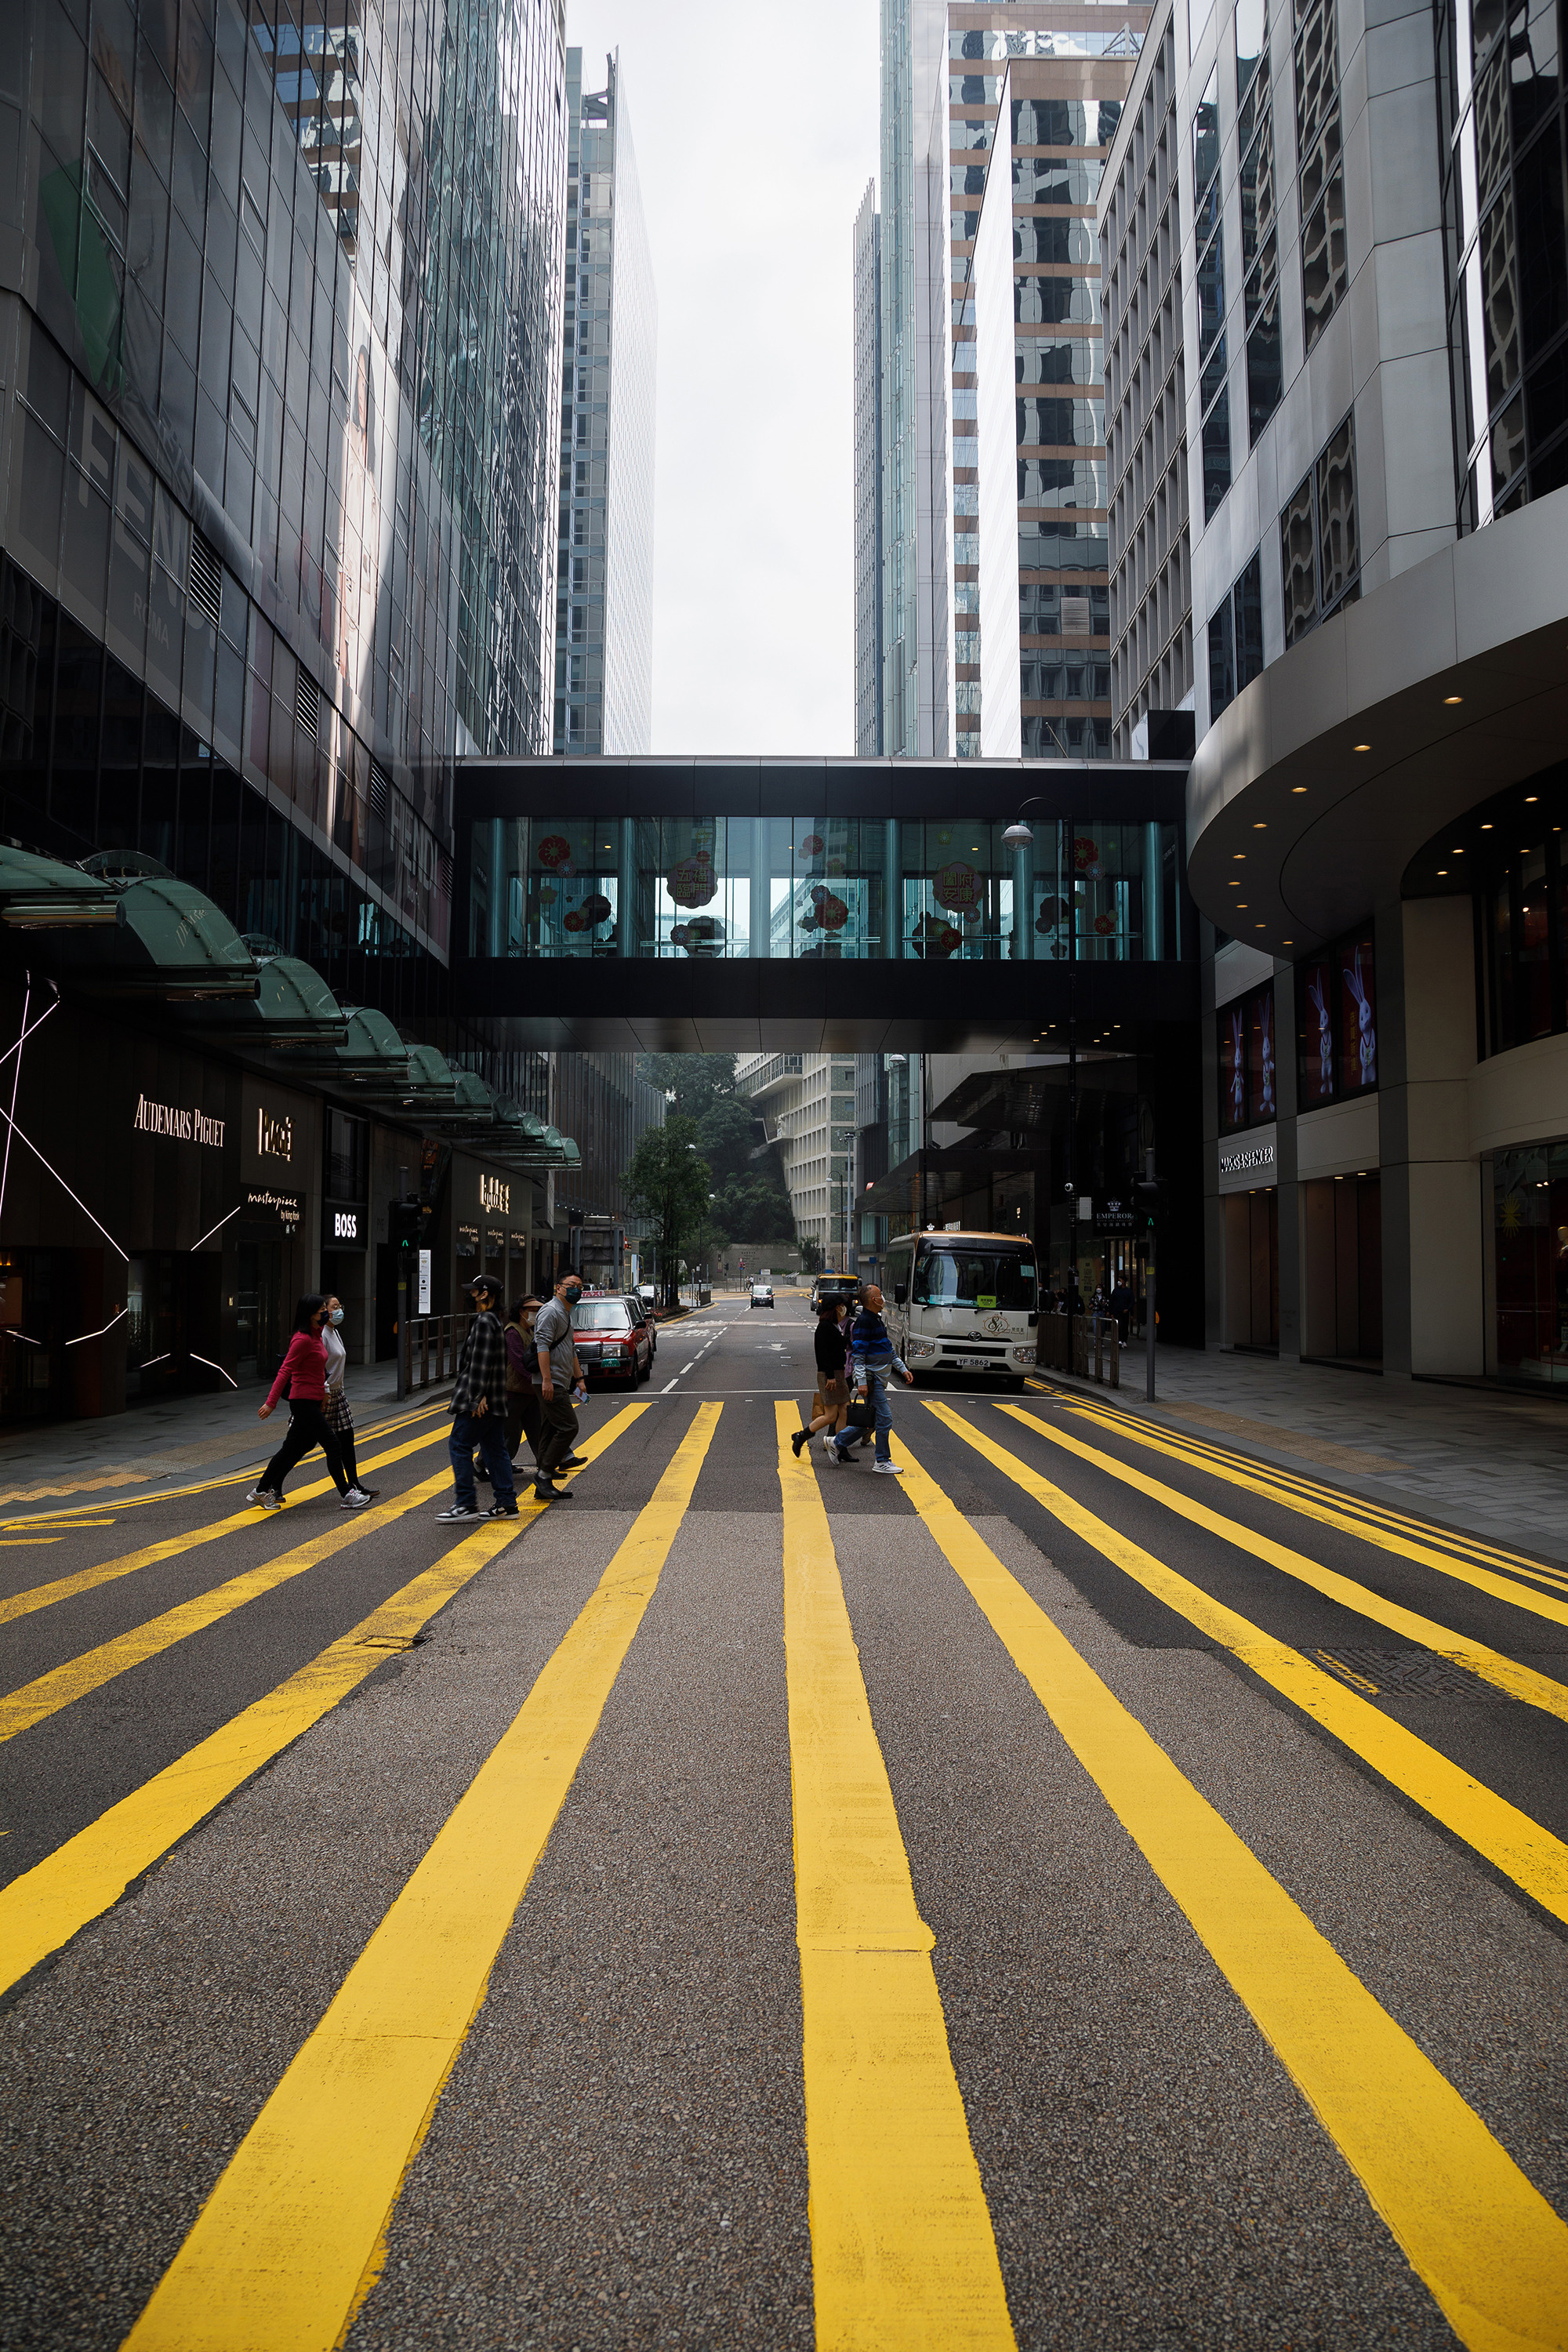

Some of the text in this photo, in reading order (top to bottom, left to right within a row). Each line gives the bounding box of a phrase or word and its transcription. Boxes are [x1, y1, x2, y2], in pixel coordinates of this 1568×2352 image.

[79, 388, 216, 652] FEN
[132, 592, 169, 650] ROMA
[390, 783, 438, 899] FENDI
[133, 1093, 226, 1148] AUDEMARS PIGUET
[248, 1190, 298, 1211] masterpiece
[334, 1213, 358, 1239] BOSS
